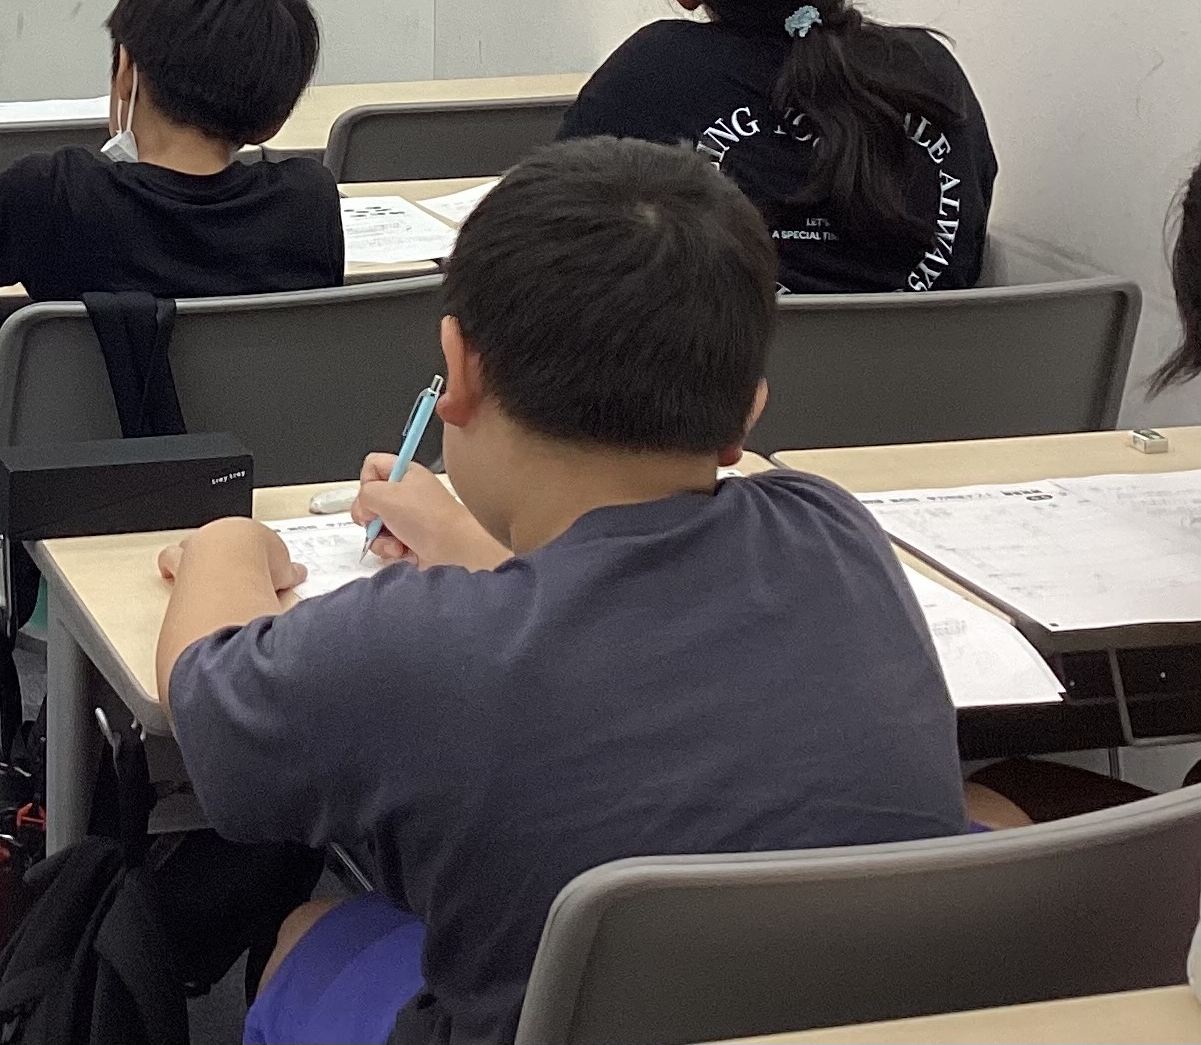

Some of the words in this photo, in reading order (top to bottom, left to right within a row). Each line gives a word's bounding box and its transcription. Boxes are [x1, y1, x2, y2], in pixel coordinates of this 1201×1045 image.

[696, 106, 761, 171] ING
[904, 112, 951, 164] LE
[781, 230, 821, 240] SPECIAL
[908, 169, 961, 291] ALWAYS
